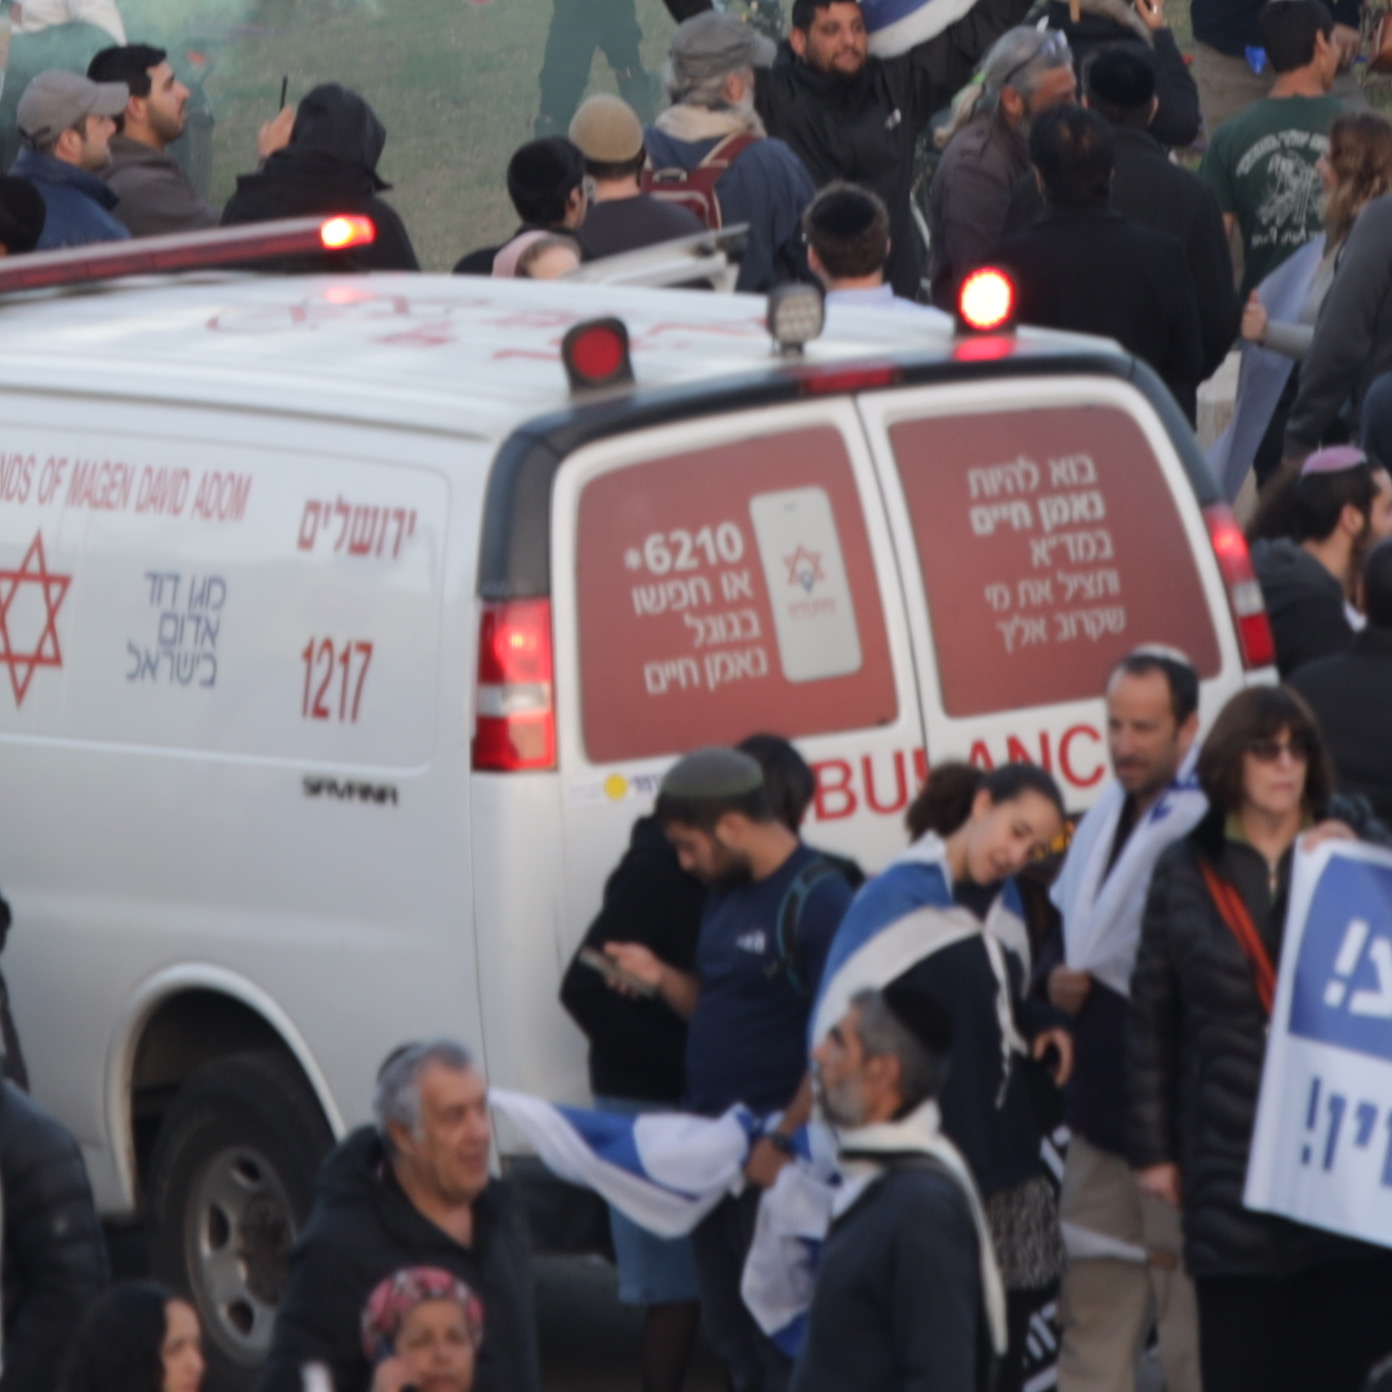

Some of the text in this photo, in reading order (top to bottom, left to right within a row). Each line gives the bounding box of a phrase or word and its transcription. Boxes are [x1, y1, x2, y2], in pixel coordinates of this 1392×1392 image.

[38, 454, 68, 506] OF
[64, 458, 136, 513] MAGEN
[134, 464, 192, 518] DAVID
[190, 468, 254, 523] ADOM
[968, 453, 1097, 499] בוא להיות
[297, 493, 417, 559] ירושלים
[969, 489, 1106, 537] נאמן חיים
[144, 571, 181, 608] דוד
[631, 569, 753, 618] או חפשו
[984, 568, 1121, 613] ותציל את מי
[158, 611, 220, 649] אדום
[682, 609, 761, 649] בגוגל
[1054, 606, 1127, 643] שקרוב
[125, 638, 218, 689] בישראל
[302, 634, 374, 724] 1217
[643, 645, 769, 695] נאמן חיים
